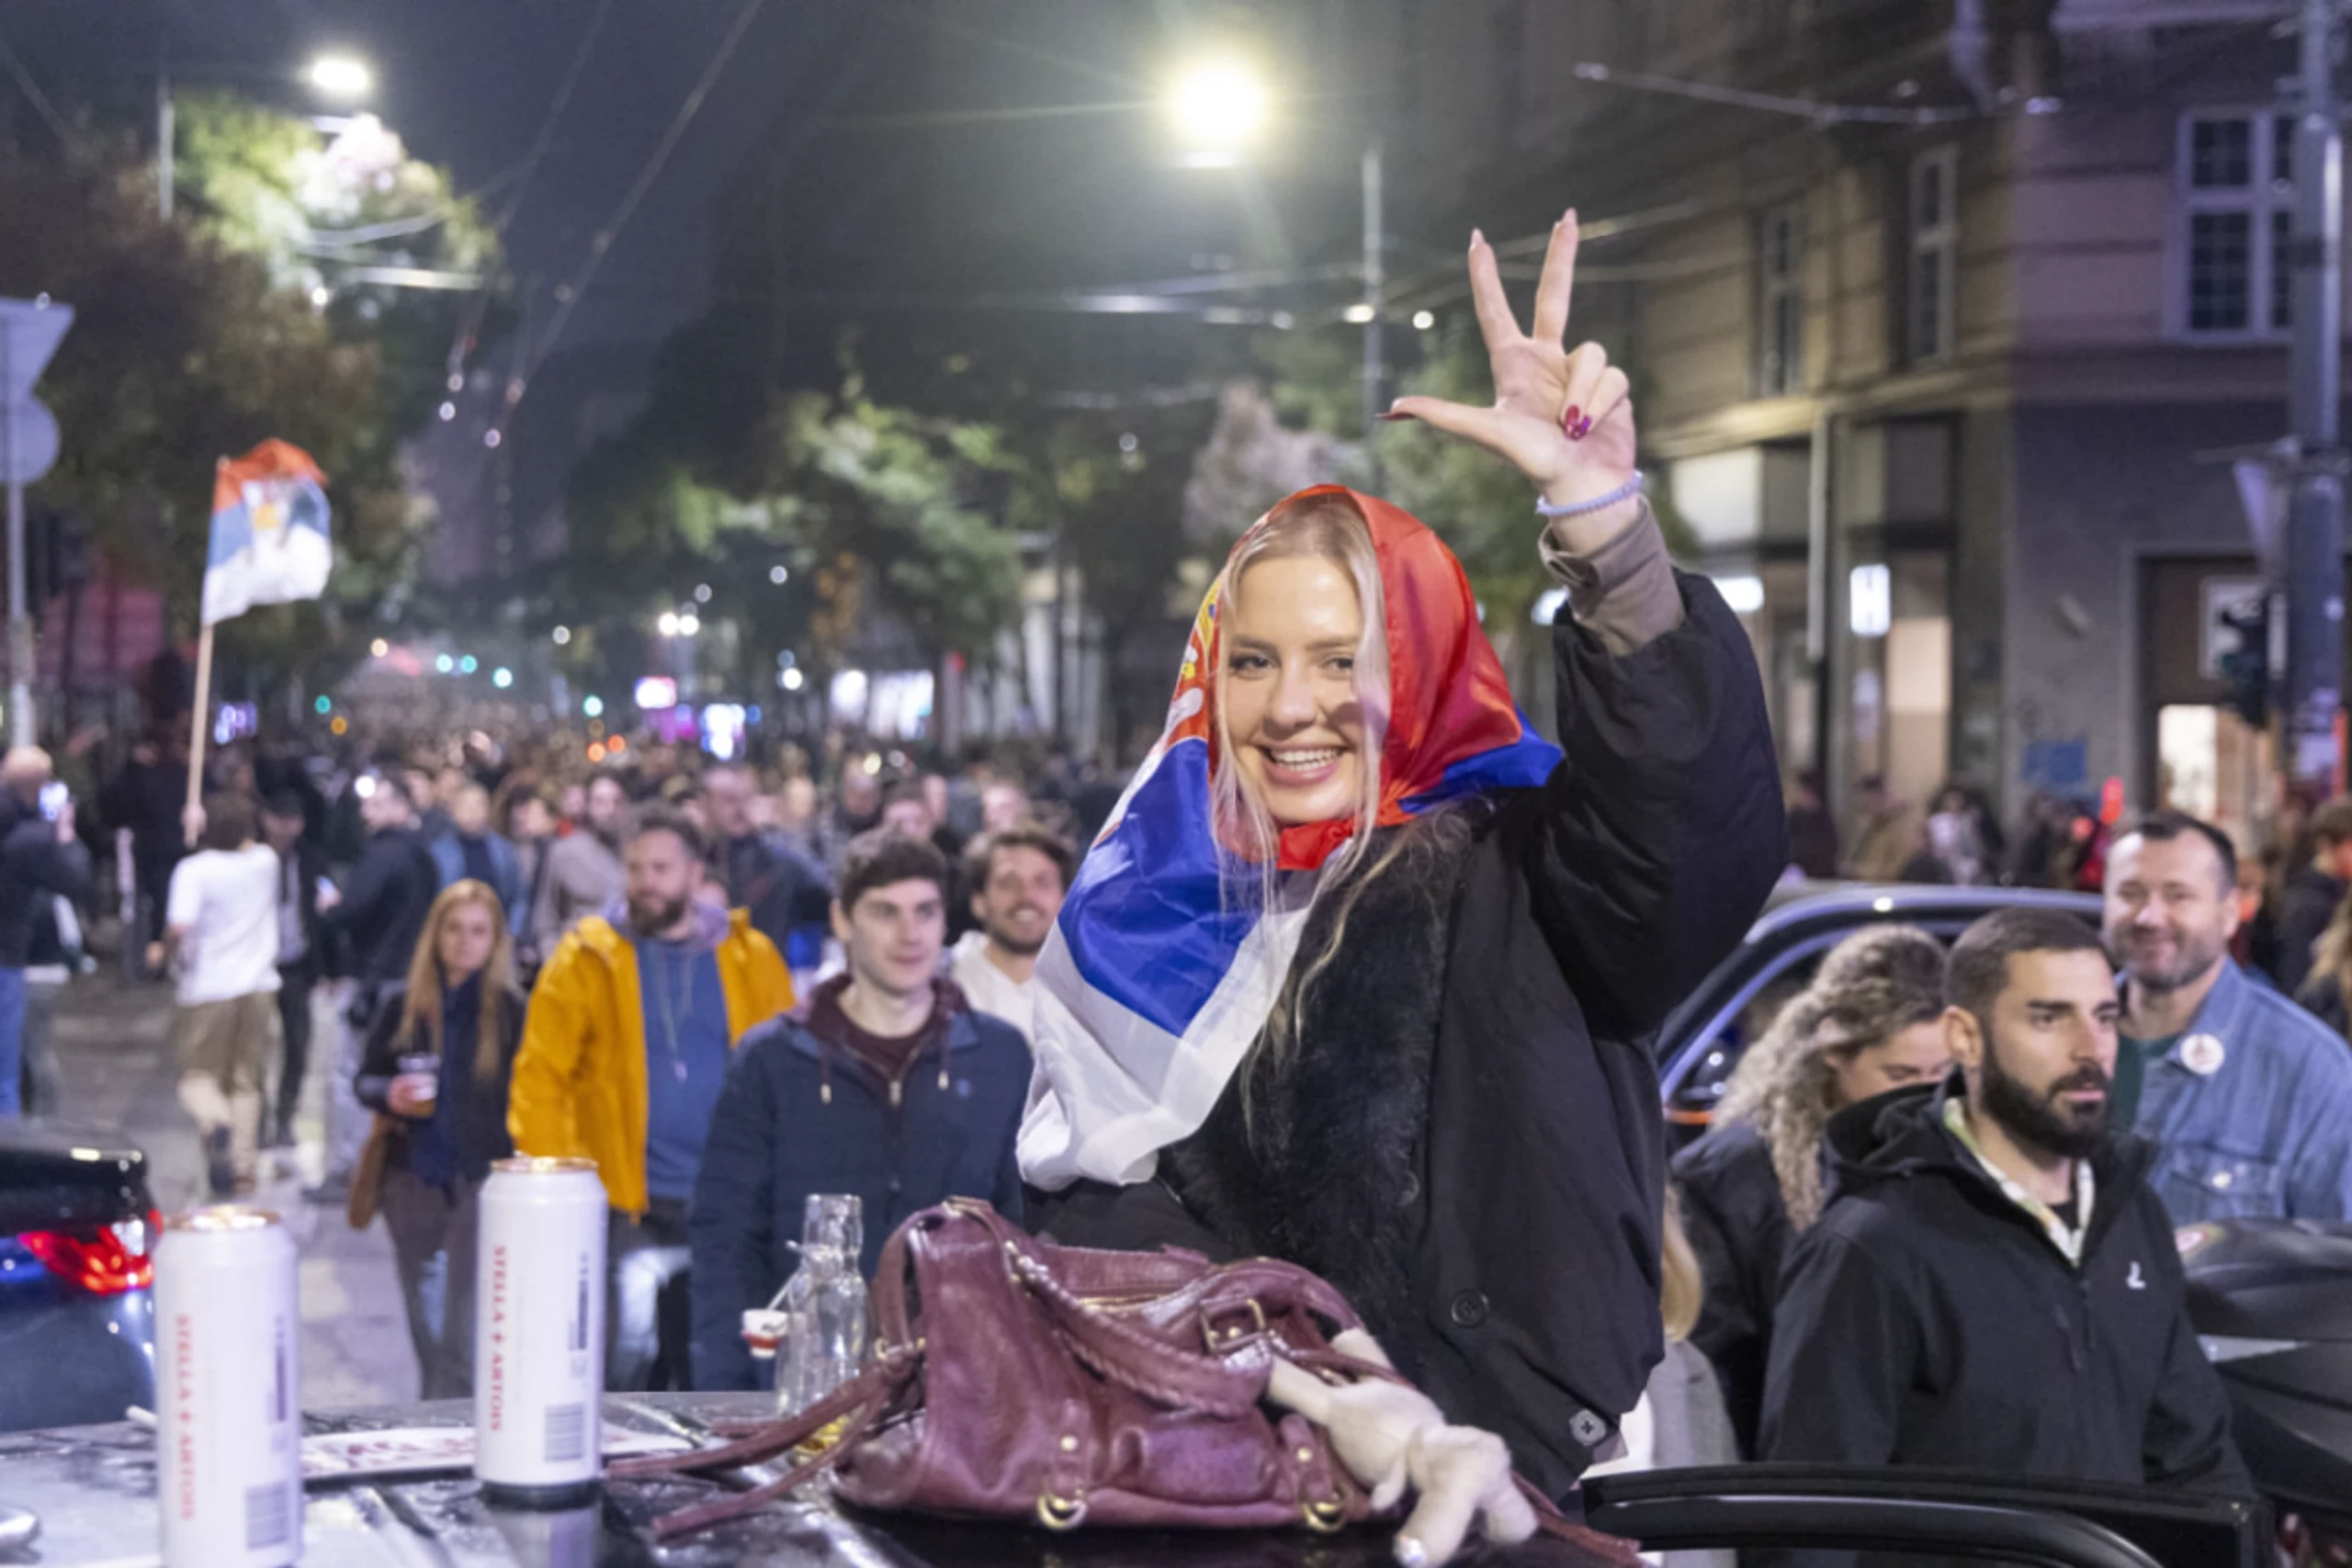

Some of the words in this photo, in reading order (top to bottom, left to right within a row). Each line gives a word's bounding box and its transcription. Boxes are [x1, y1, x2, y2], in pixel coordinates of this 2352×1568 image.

[492, 1246, 506, 1324] STELLA
[175, 1314, 192, 1401] STELLA
[490, 1352, 504, 1432] ARTOIS
[179, 1435, 194, 1521] ARTOIS
